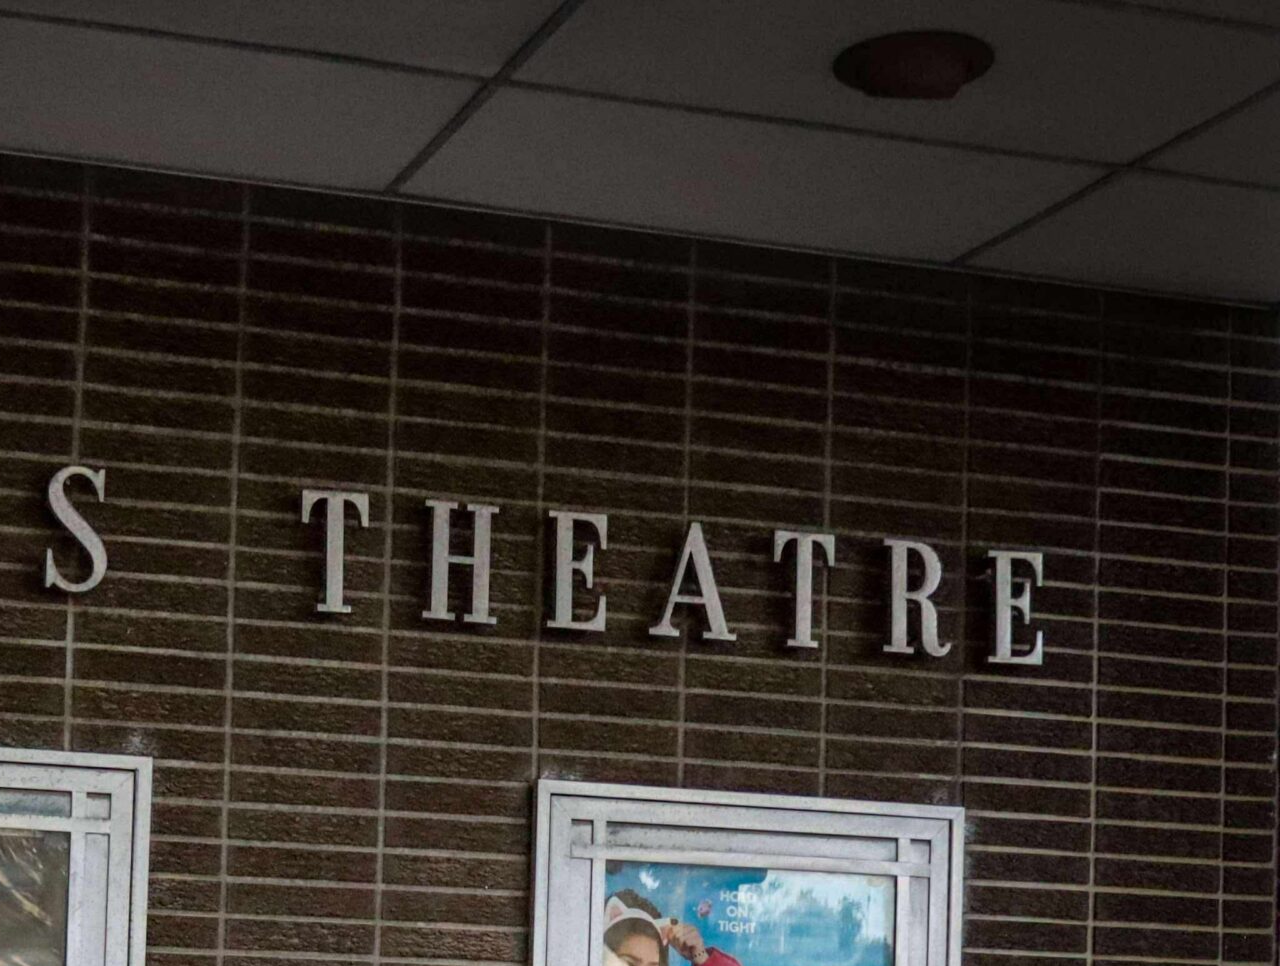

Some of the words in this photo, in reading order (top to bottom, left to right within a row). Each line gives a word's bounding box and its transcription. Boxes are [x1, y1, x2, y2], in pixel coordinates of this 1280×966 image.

[301, 489, 1044, 665] THEATRE
[726, 905, 748, 917] ON
[718, 920, 756, 933] TIGHT
